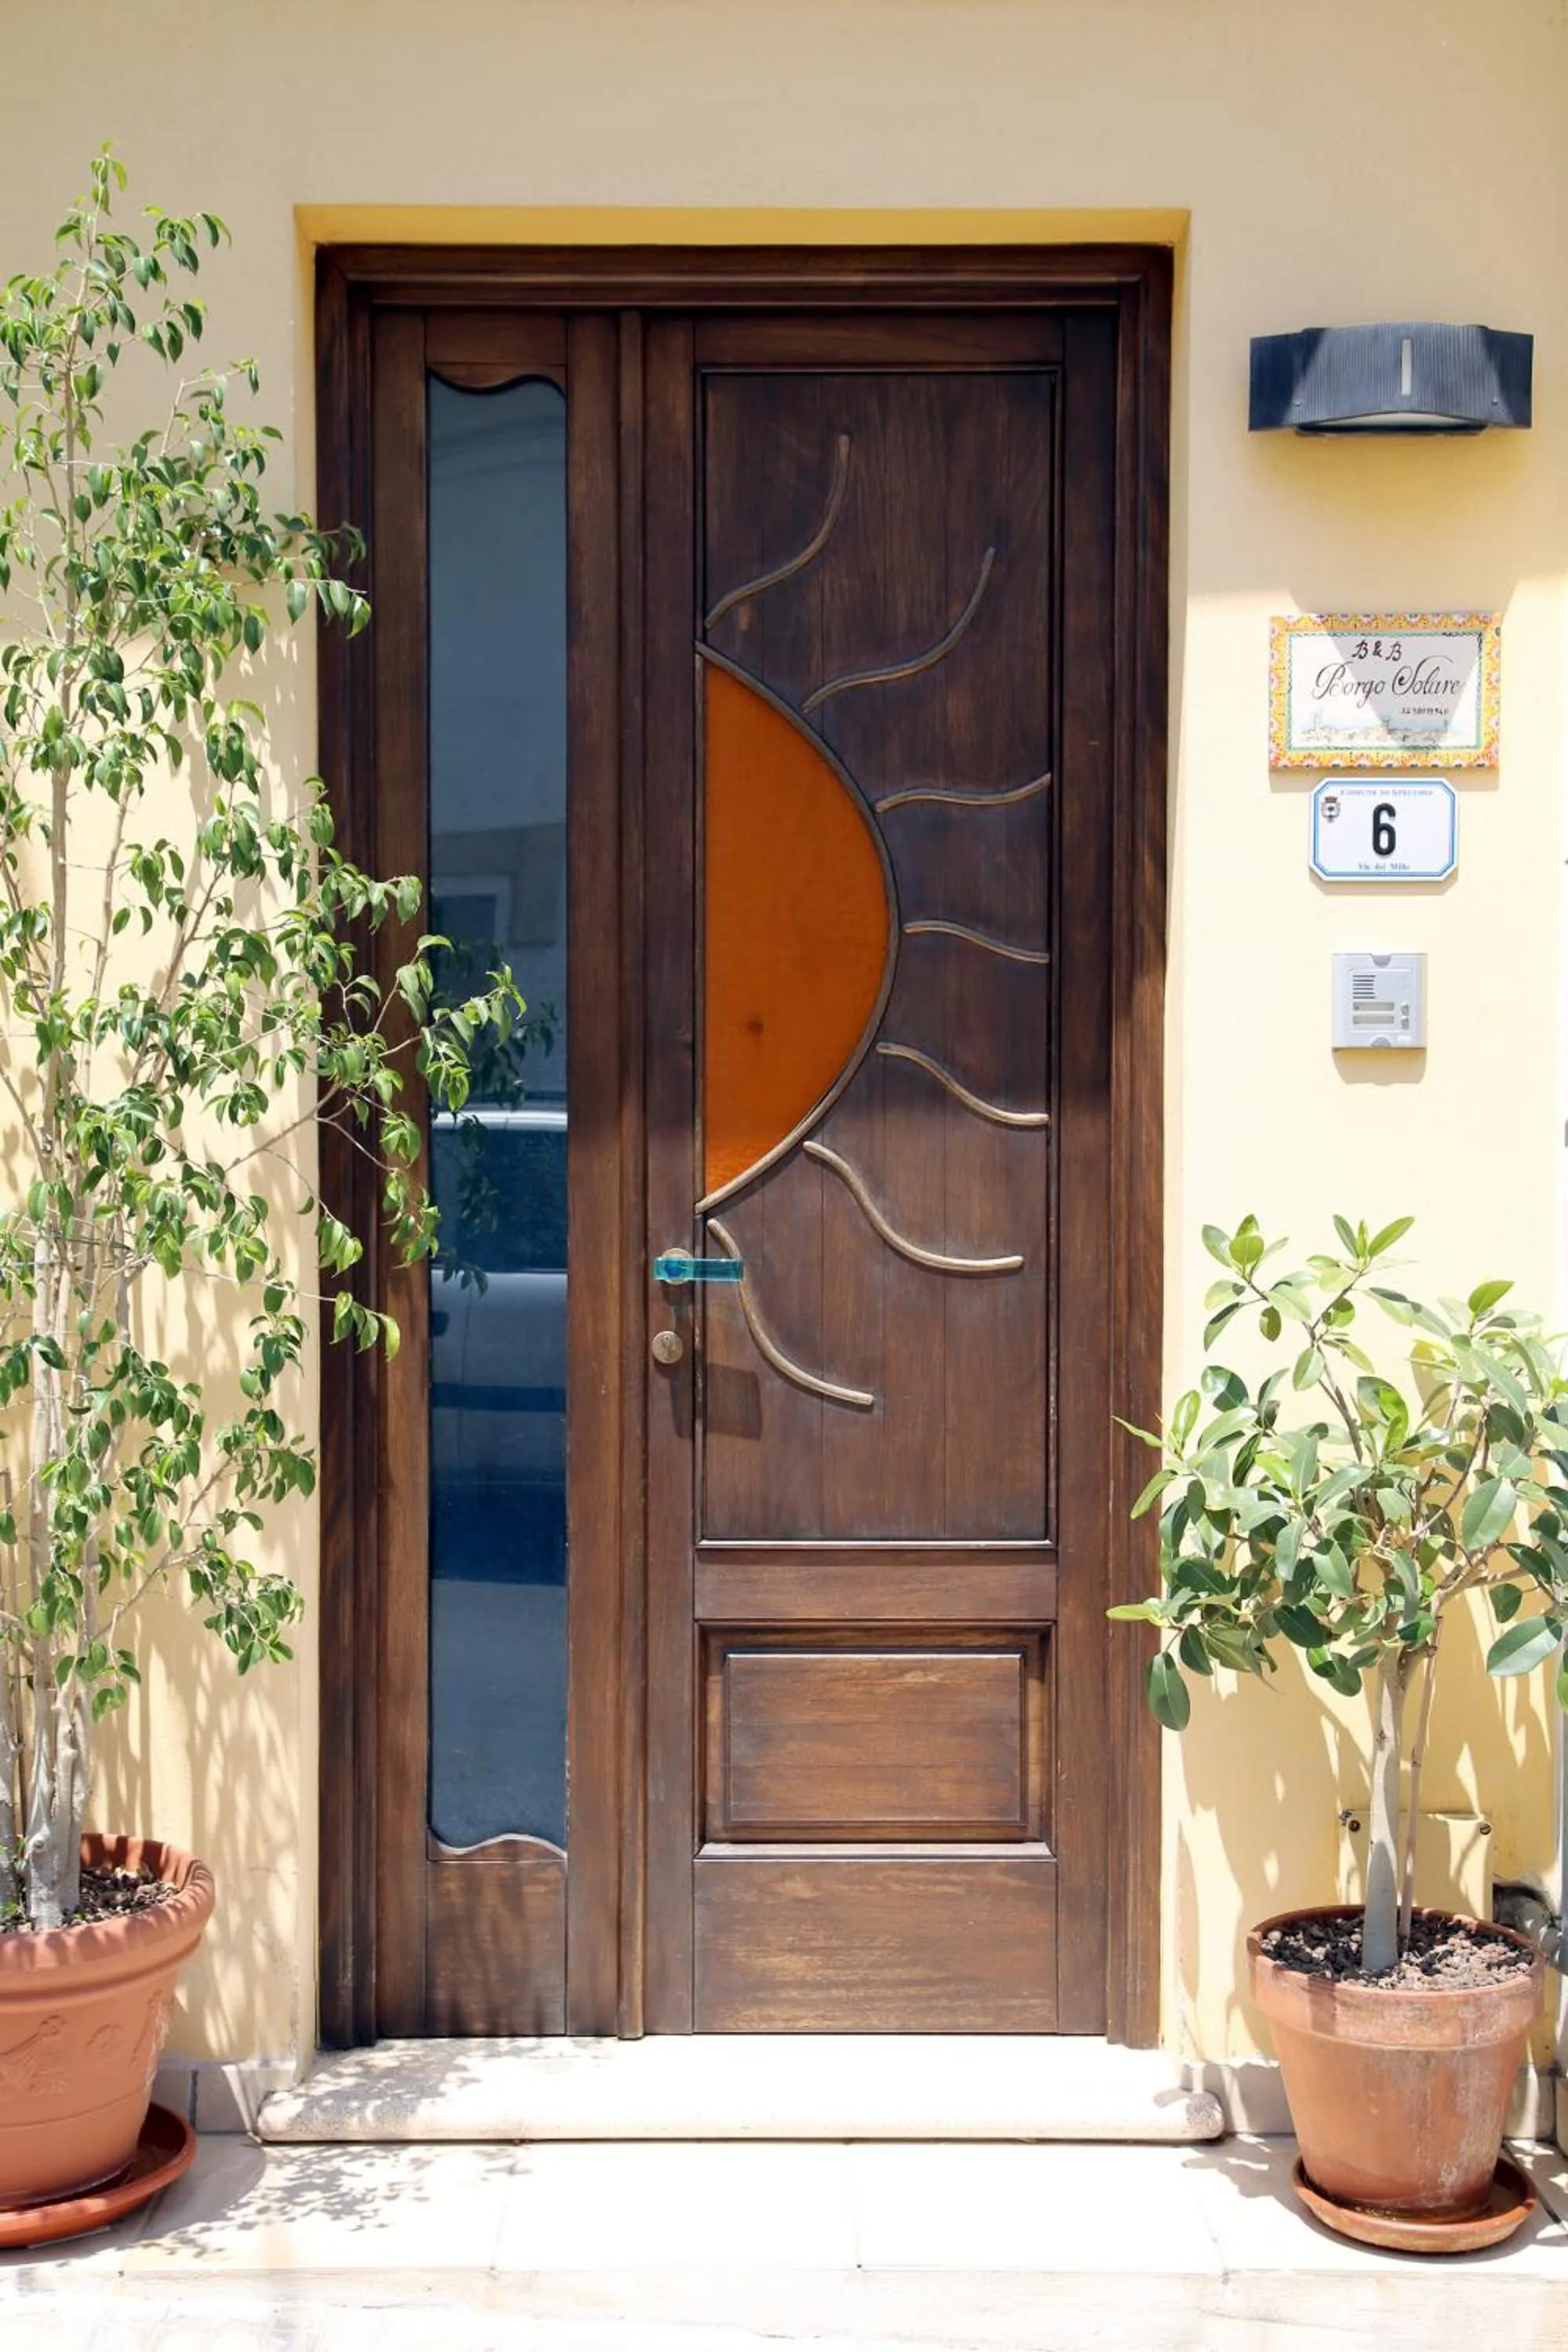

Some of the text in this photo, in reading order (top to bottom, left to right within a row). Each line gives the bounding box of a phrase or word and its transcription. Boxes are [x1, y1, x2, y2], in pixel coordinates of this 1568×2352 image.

[1312, 655, 1465, 708] Borgo Solare
[1373, 802, 1396, 855] 6
